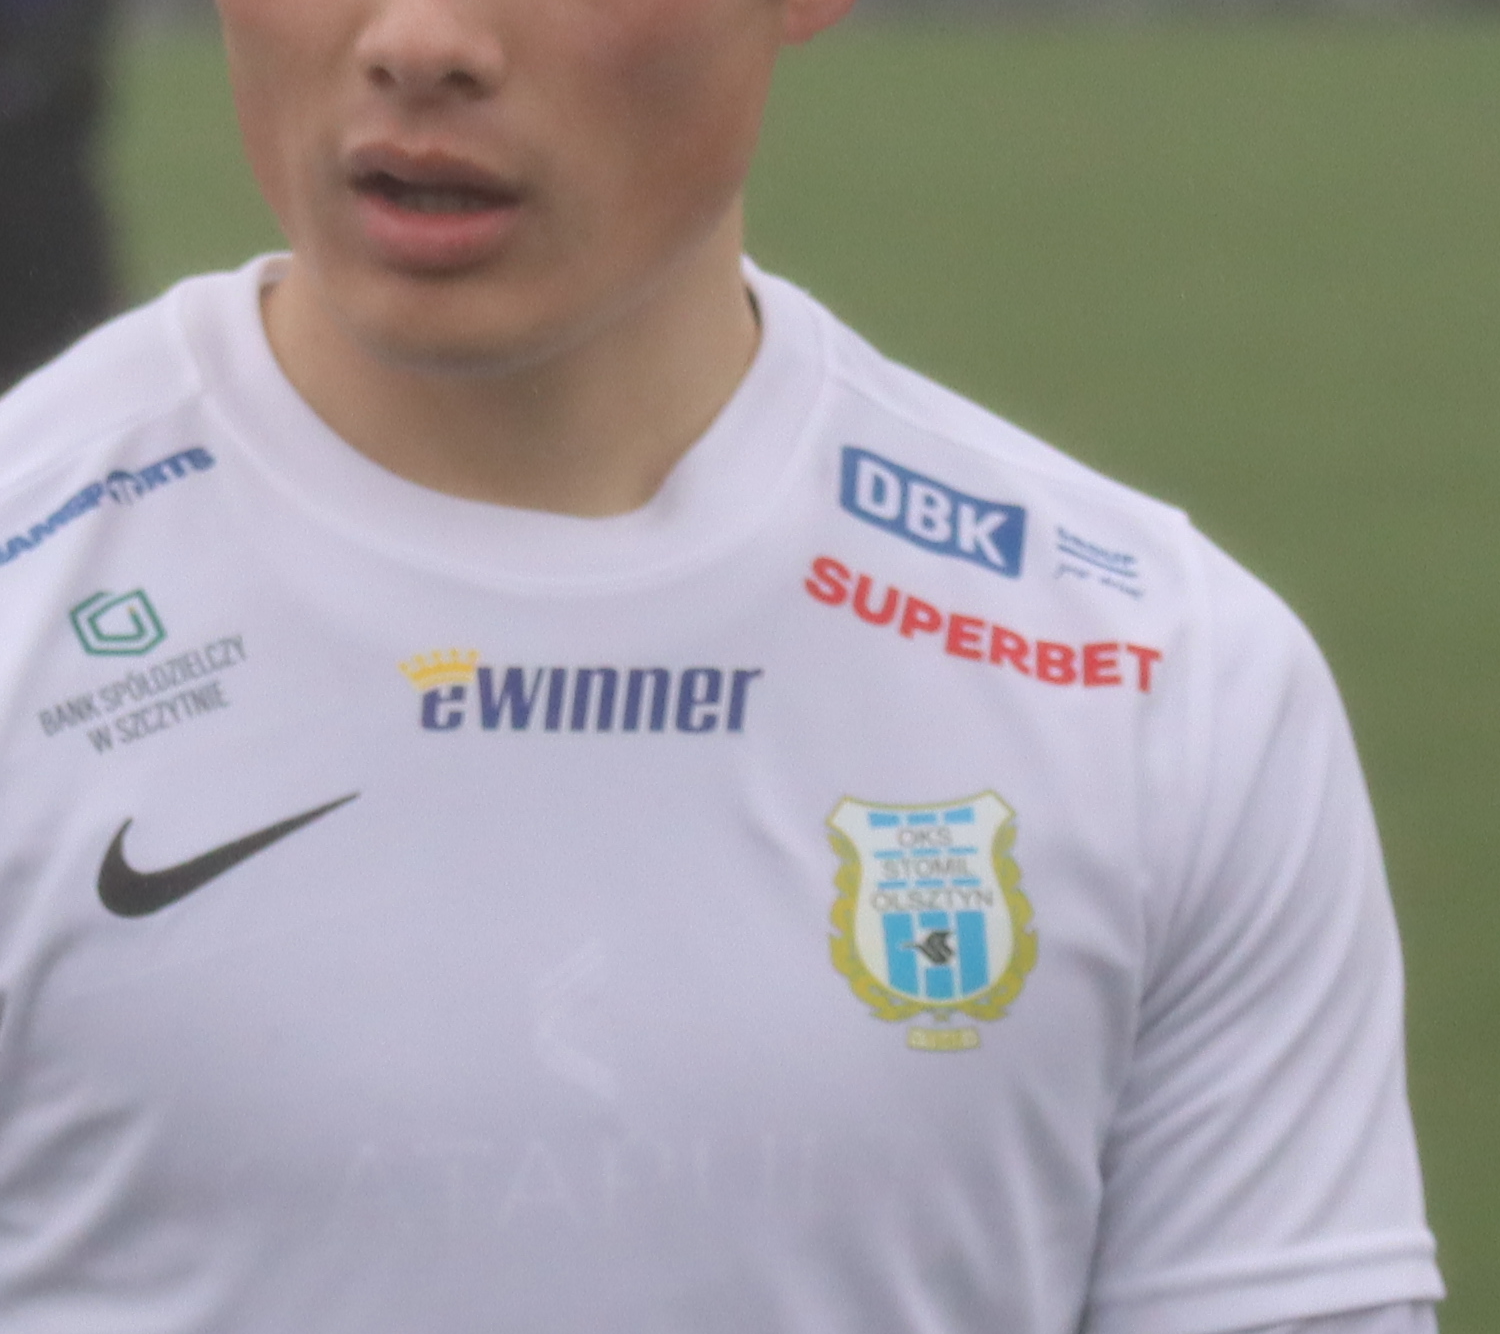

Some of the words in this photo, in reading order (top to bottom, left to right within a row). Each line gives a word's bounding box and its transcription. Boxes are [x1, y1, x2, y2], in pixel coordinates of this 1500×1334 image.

[854, 458, 1007, 569] DBK
[804, 554, 1163, 693] SUPERBET
[38, 692, 101, 737] BANK
